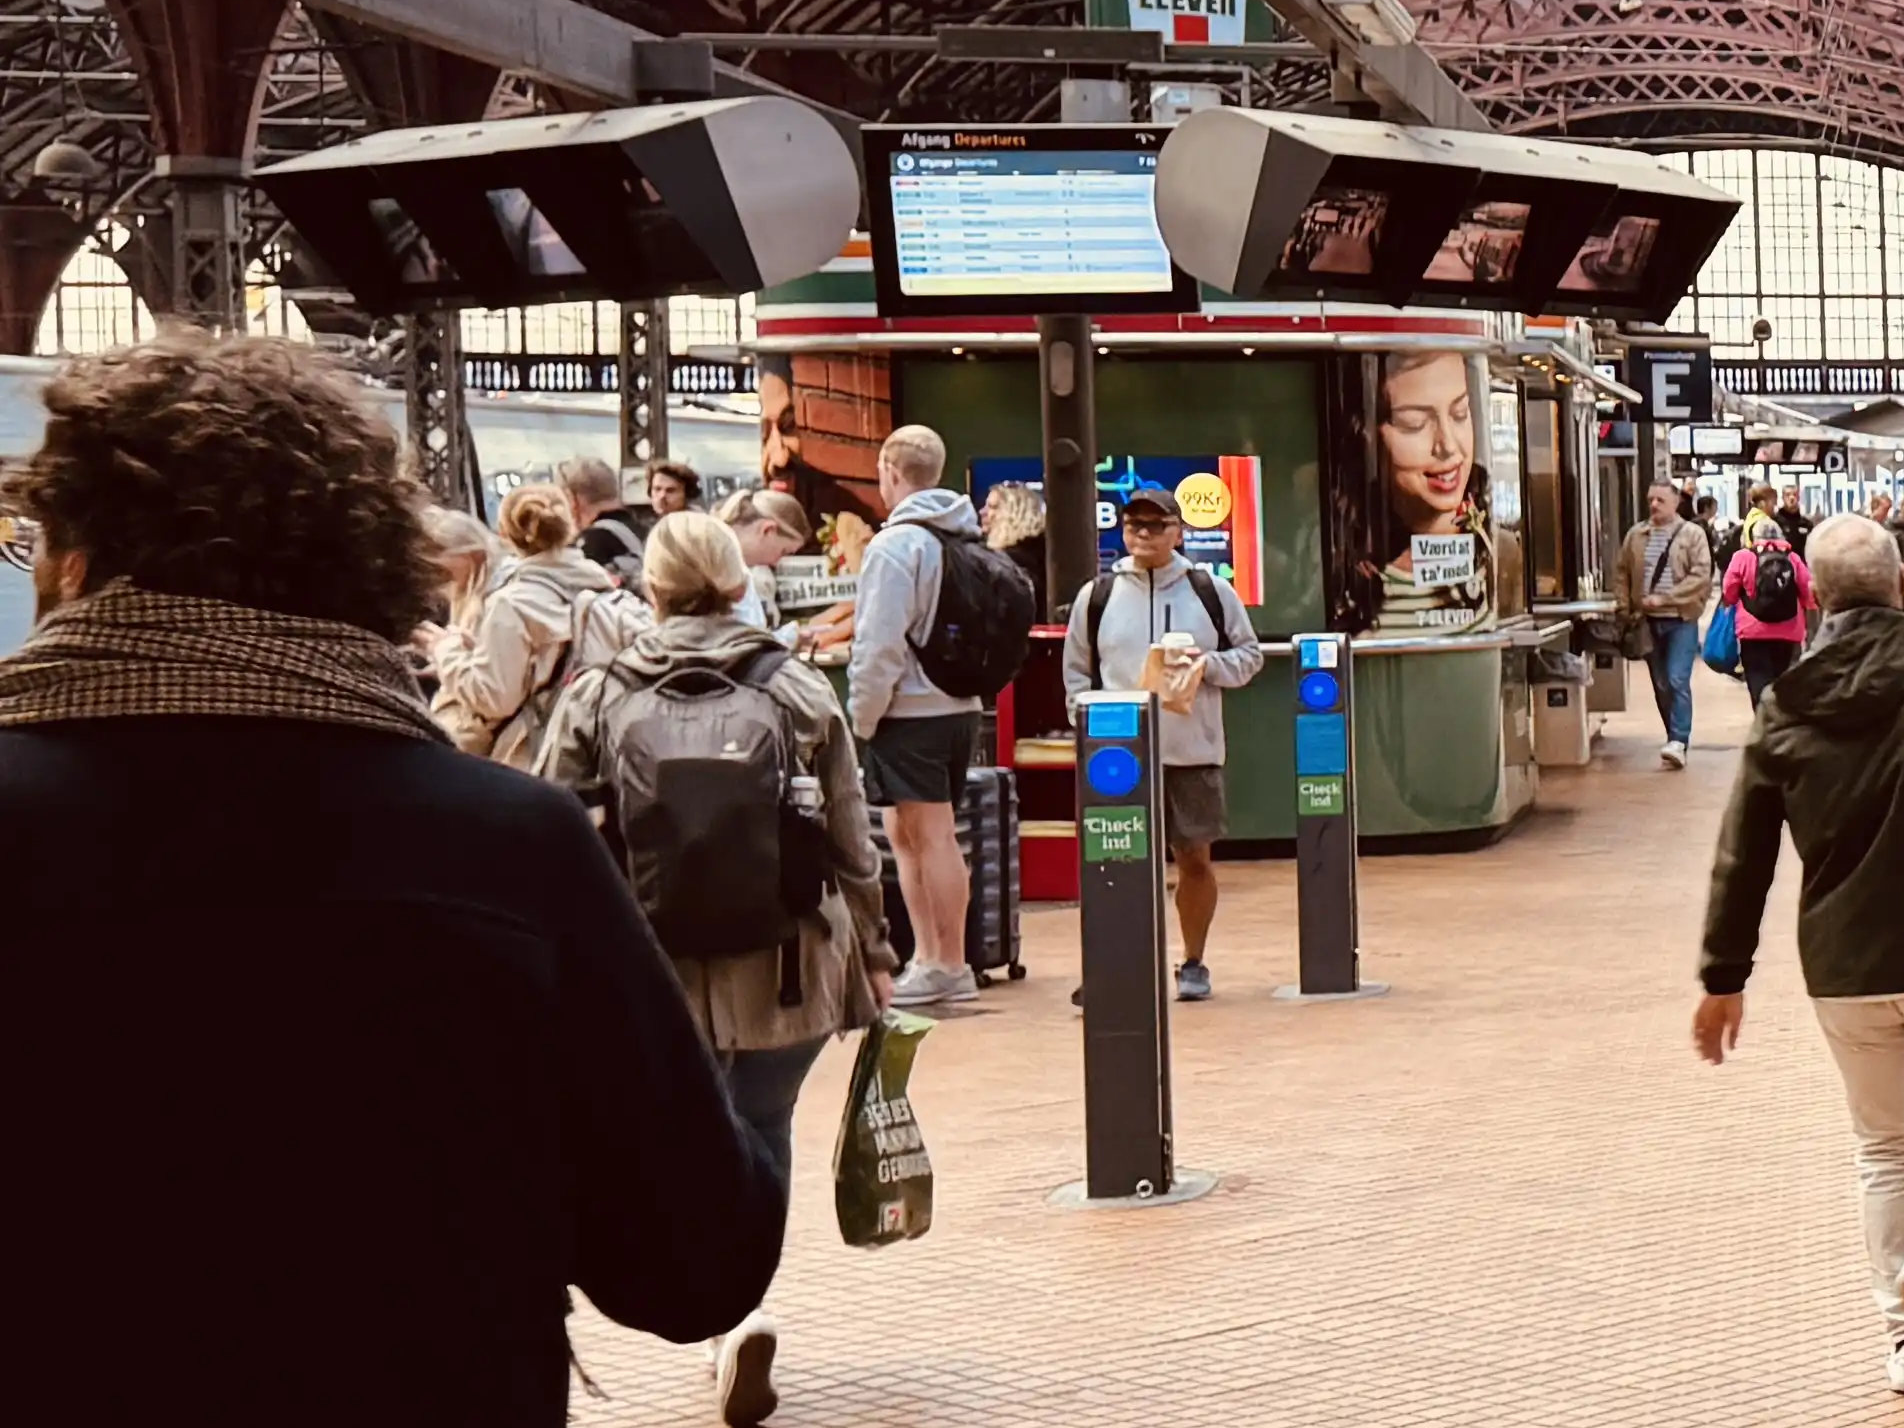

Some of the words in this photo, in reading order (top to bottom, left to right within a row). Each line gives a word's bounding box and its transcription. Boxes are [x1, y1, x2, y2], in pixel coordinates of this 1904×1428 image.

[902, 132, 950, 149] Afgang
[954, 132, 1026, 149] Departures
[1652, 363, 1691, 418] E
[1825, 451, 1844, 472] D
[1418, 539, 1456, 556] Værd
[1443, 561, 1469, 580] med
[1086, 816, 1145, 834] Check
